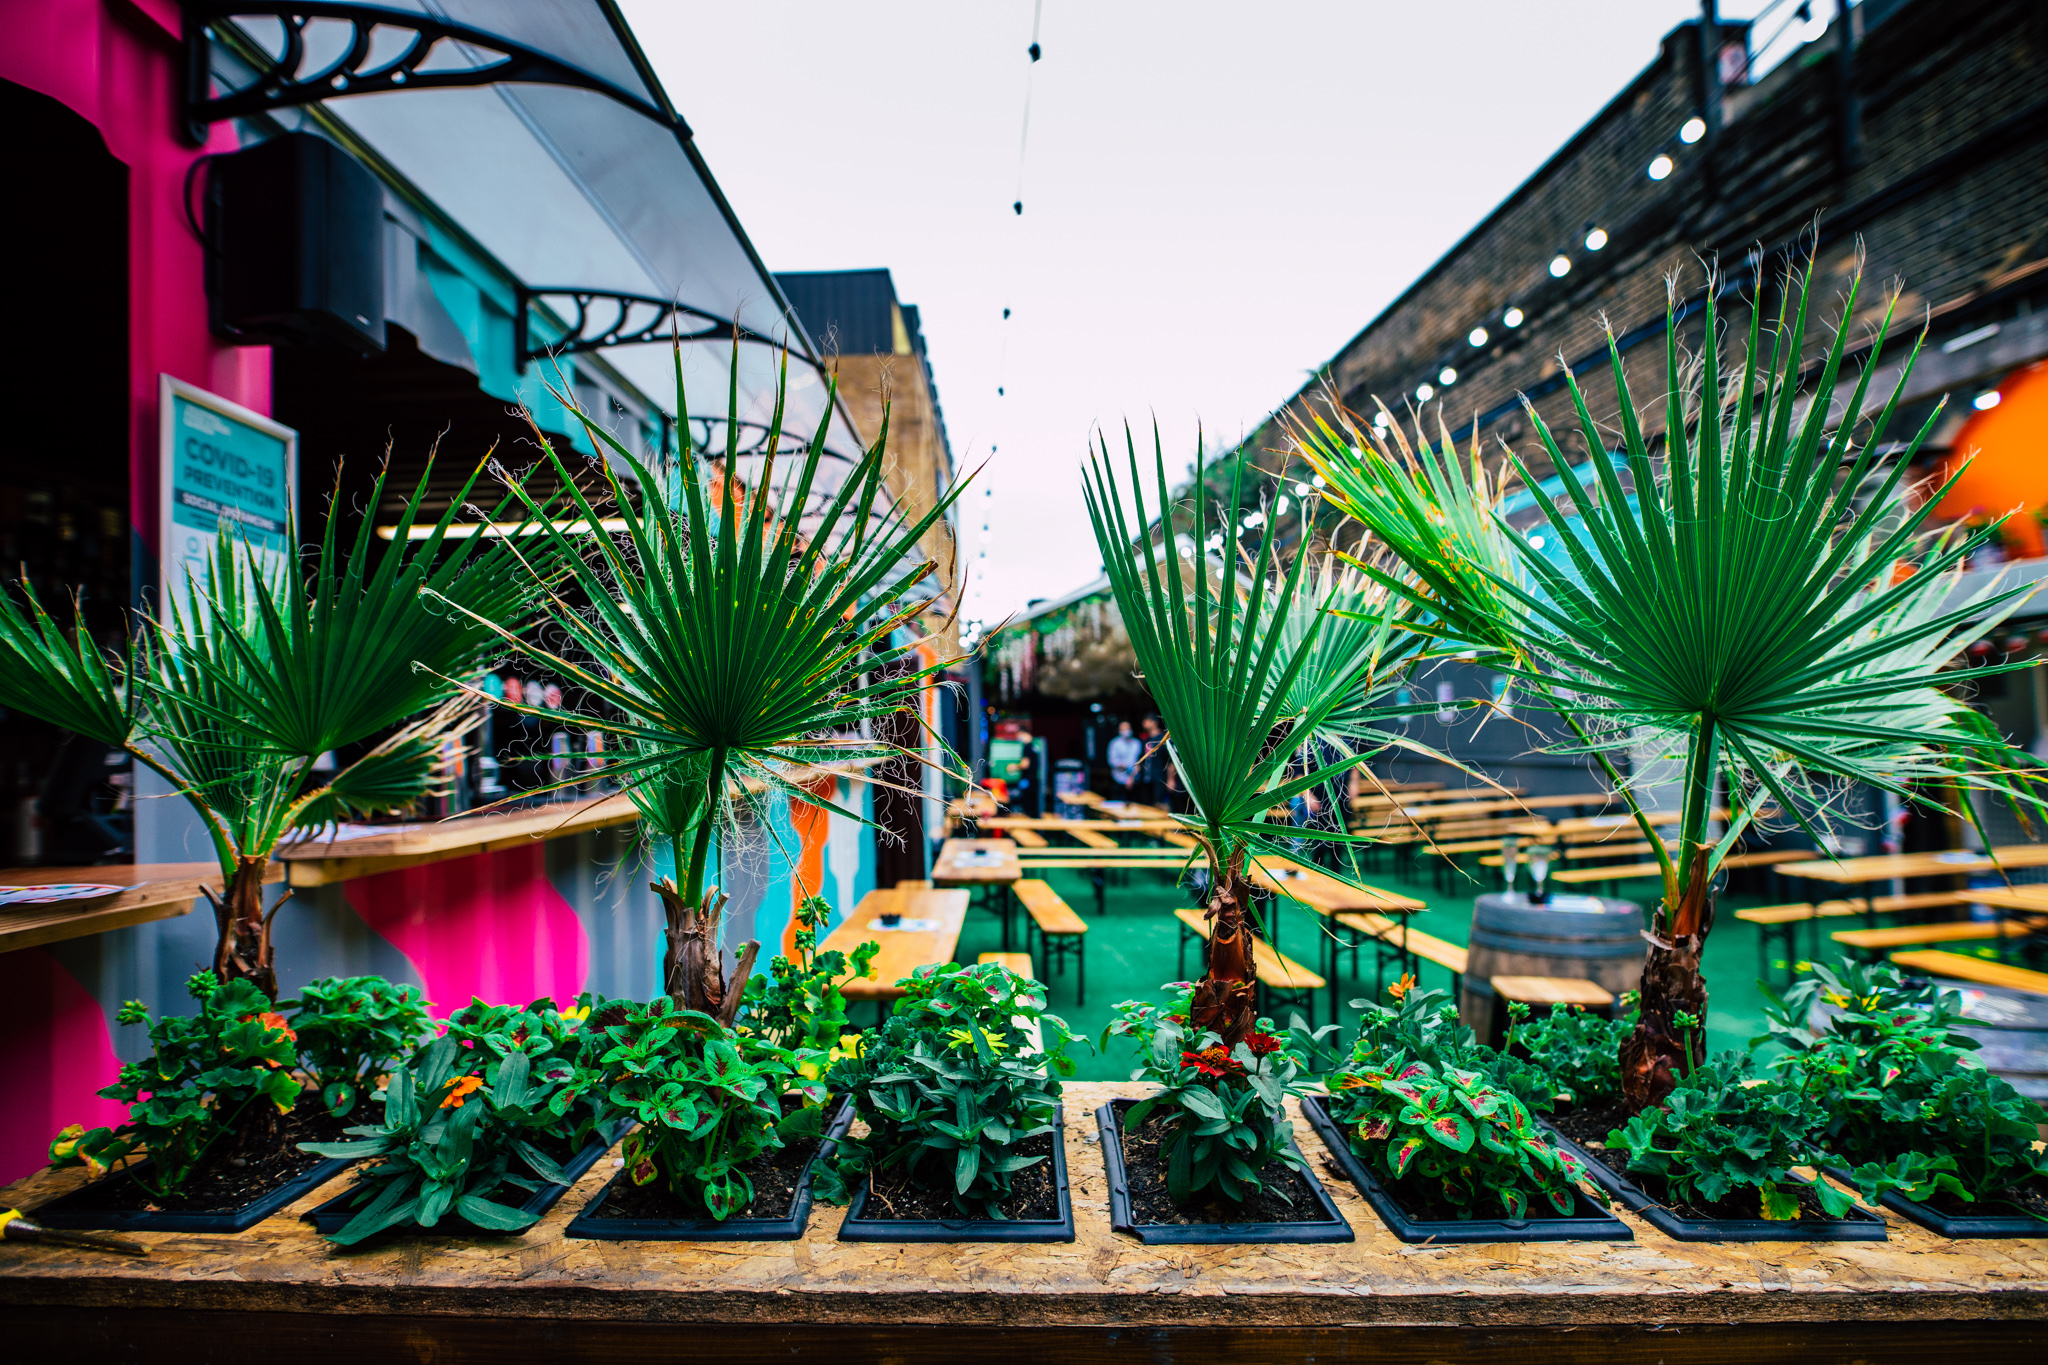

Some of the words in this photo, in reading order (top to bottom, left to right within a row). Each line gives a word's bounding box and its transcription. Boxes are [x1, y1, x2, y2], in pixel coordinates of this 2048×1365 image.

[185, 437, 274, 489] COVID-19
[182, 492, 219, 515] SOCIAL
[183, 465, 275, 510] PREVENTION
